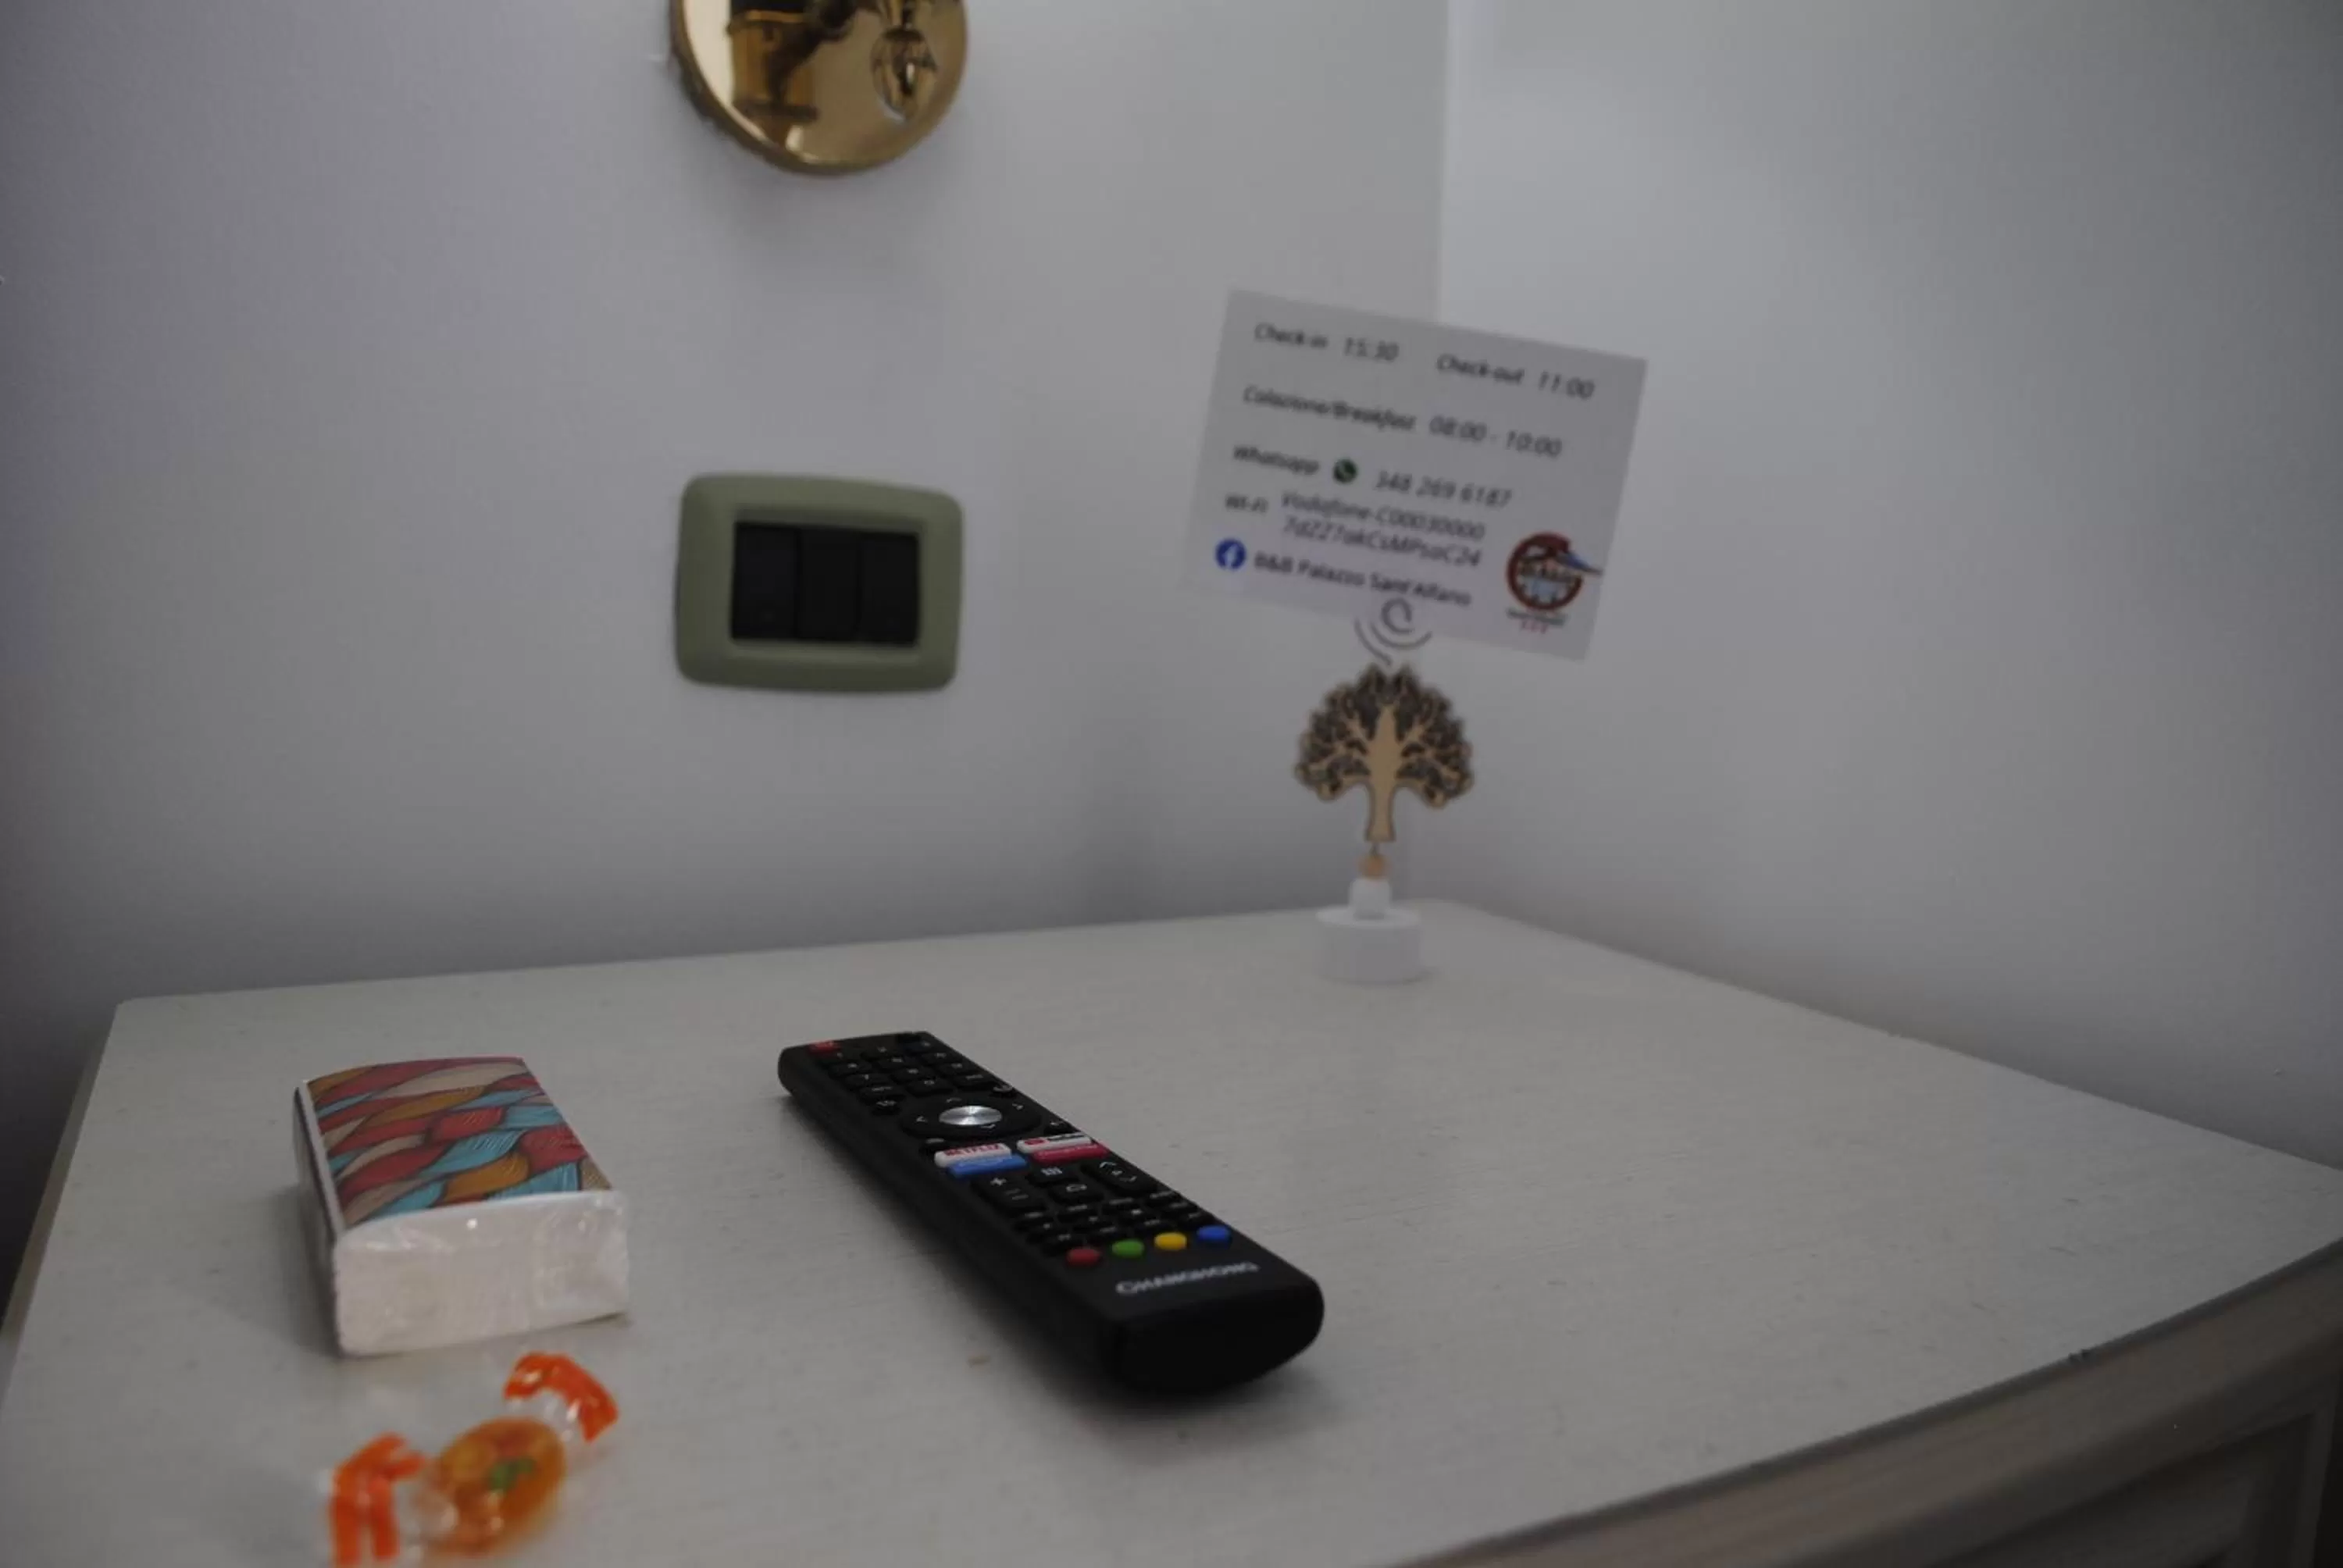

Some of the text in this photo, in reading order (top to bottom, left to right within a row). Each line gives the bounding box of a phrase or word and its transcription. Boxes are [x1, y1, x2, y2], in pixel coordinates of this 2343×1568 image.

[1436, 352, 1525, 385] Check-out
[1538, 369, 1596, 401] 11:00
[1429, 415, 1487, 441] 08:00
[1506, 429, 1563, 458] 10:00
